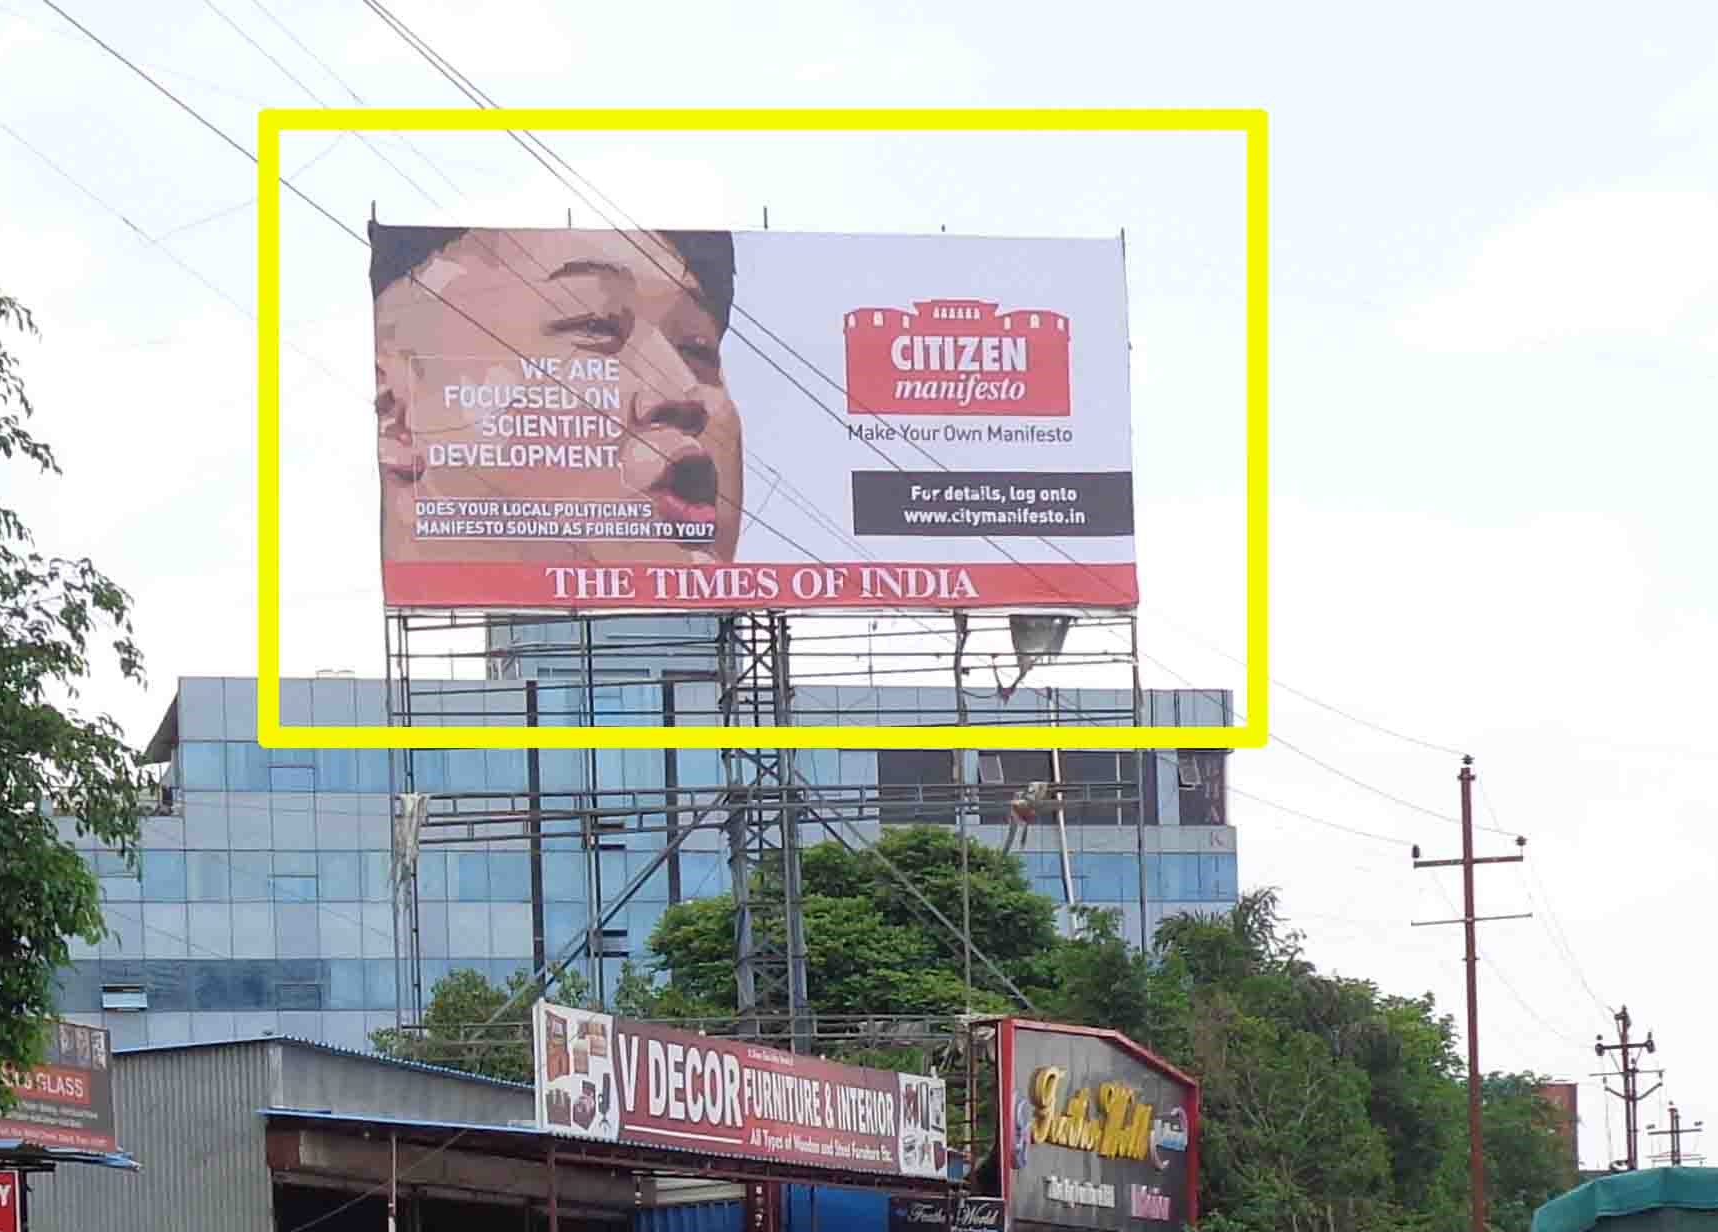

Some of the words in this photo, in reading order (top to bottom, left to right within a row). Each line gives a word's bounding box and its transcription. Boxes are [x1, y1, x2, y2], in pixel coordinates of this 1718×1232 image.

[890, 335, 1027, 372] CITIZEN
[520, 357, 561, 381] WE
[570, 358, 621, 381] ARE
[443, 385, 582, 409] FOCUSSED
[584, 385, 621, 409] ON
[895, 374, 1026, 406] manifesto
[482, 415, 621, 438] SCIENTIFIC
[848, 423, 896, 442] Make
[900, 423, 941, 442] Your
[943, 424, 983, 442] Own
[987, 424, 1073, 443] Manifesto
[911, 485, 940, 501] For
[944, 485, 1006, 503] details,
[1010, 486, 1036, 506] log
[1039, 487, 1078, 501] onto
[416, 501, 456, 516] DOES
[458, 502, 499, 516] YOUR
[502, 502, 552, 517] LOCAL
[554, 502, 652, 518] POLITICIAN'S
[904, 507, 1086, 528] www.citymanifesto.in
[416, 520, 505, 536] MANIFESTO
[508, 520, 560, 536] SOUND
[562, 521, 582, 536] AS
[585, 521, 651, 537] FOREIGN
[653, 522, 673, 537] TO
[675, 522, 715, 538] YOU?
[546, 566, 636, 599] THE
[646, 566, 780, 600] TIMES
[791, 567, 848, 599] OF
[858, 567, 980, 600] INDIA
[36, 1074, 84, 1099] GLASS
[617, 1033, 640, 1113] V
[648, 1039, 744, 1128] DECOR
[744, 1067, 821, 1125] FURNITURE
[823, 1083, 834, 1129] &
[835, 1085, 897, 1137] INTERIOR
[750, 1128, 762, 1146] All
[763, 1129, 783, 1152] Types
